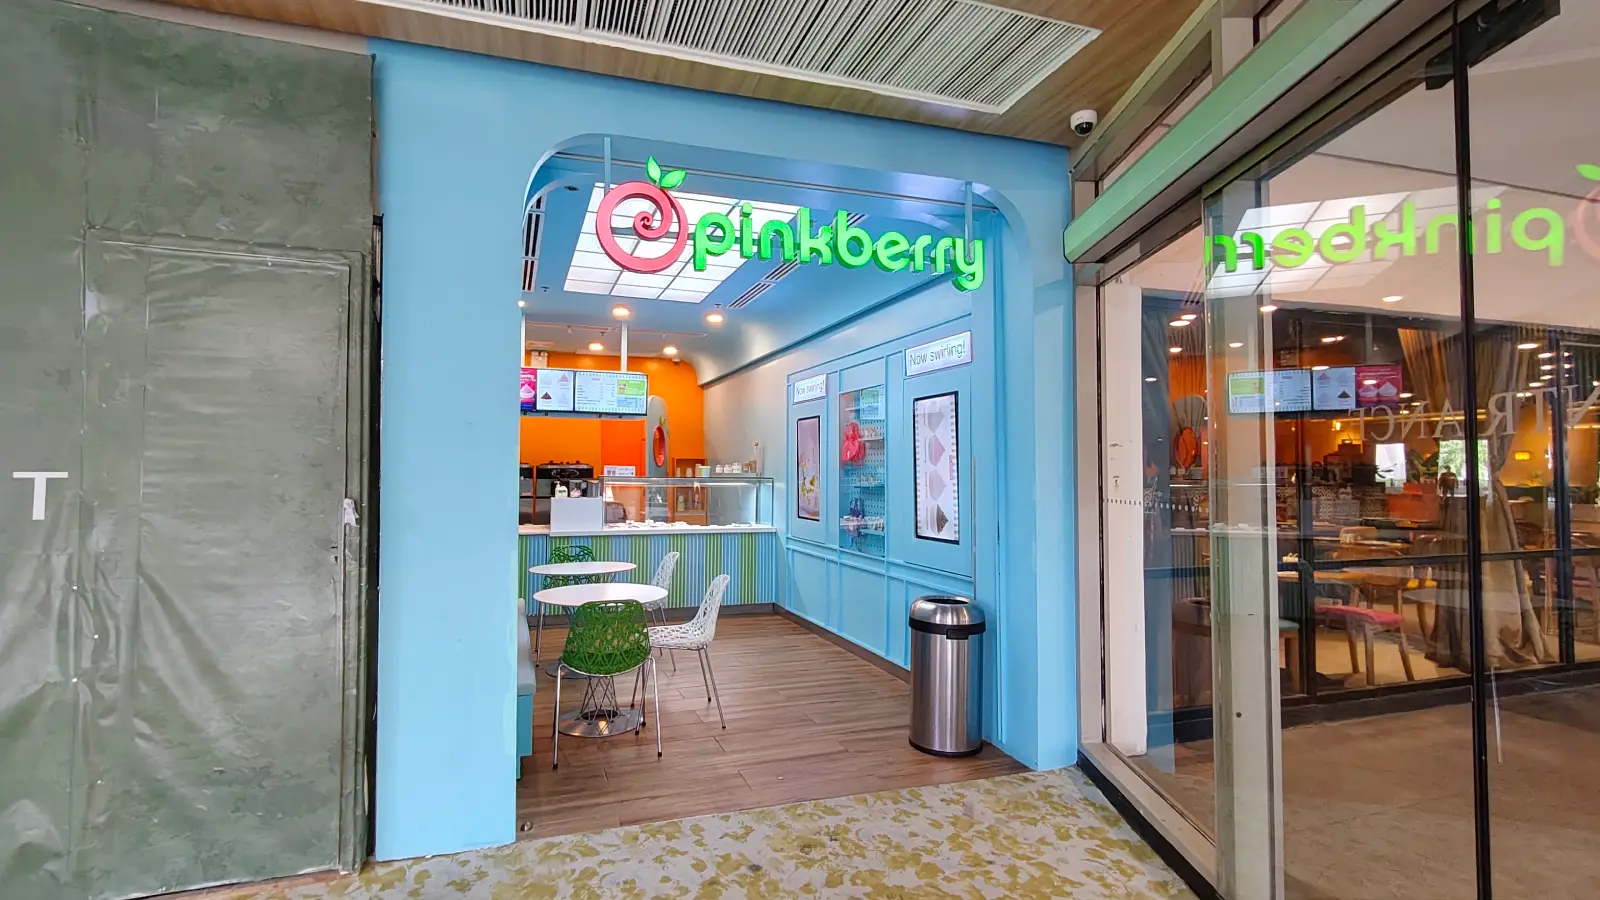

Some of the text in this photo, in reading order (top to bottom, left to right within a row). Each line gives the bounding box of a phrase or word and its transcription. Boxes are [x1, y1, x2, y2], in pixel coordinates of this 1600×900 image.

[692, 202, 985, 293] pinkberry
[909, 339, 967, 367] Now swirling!
